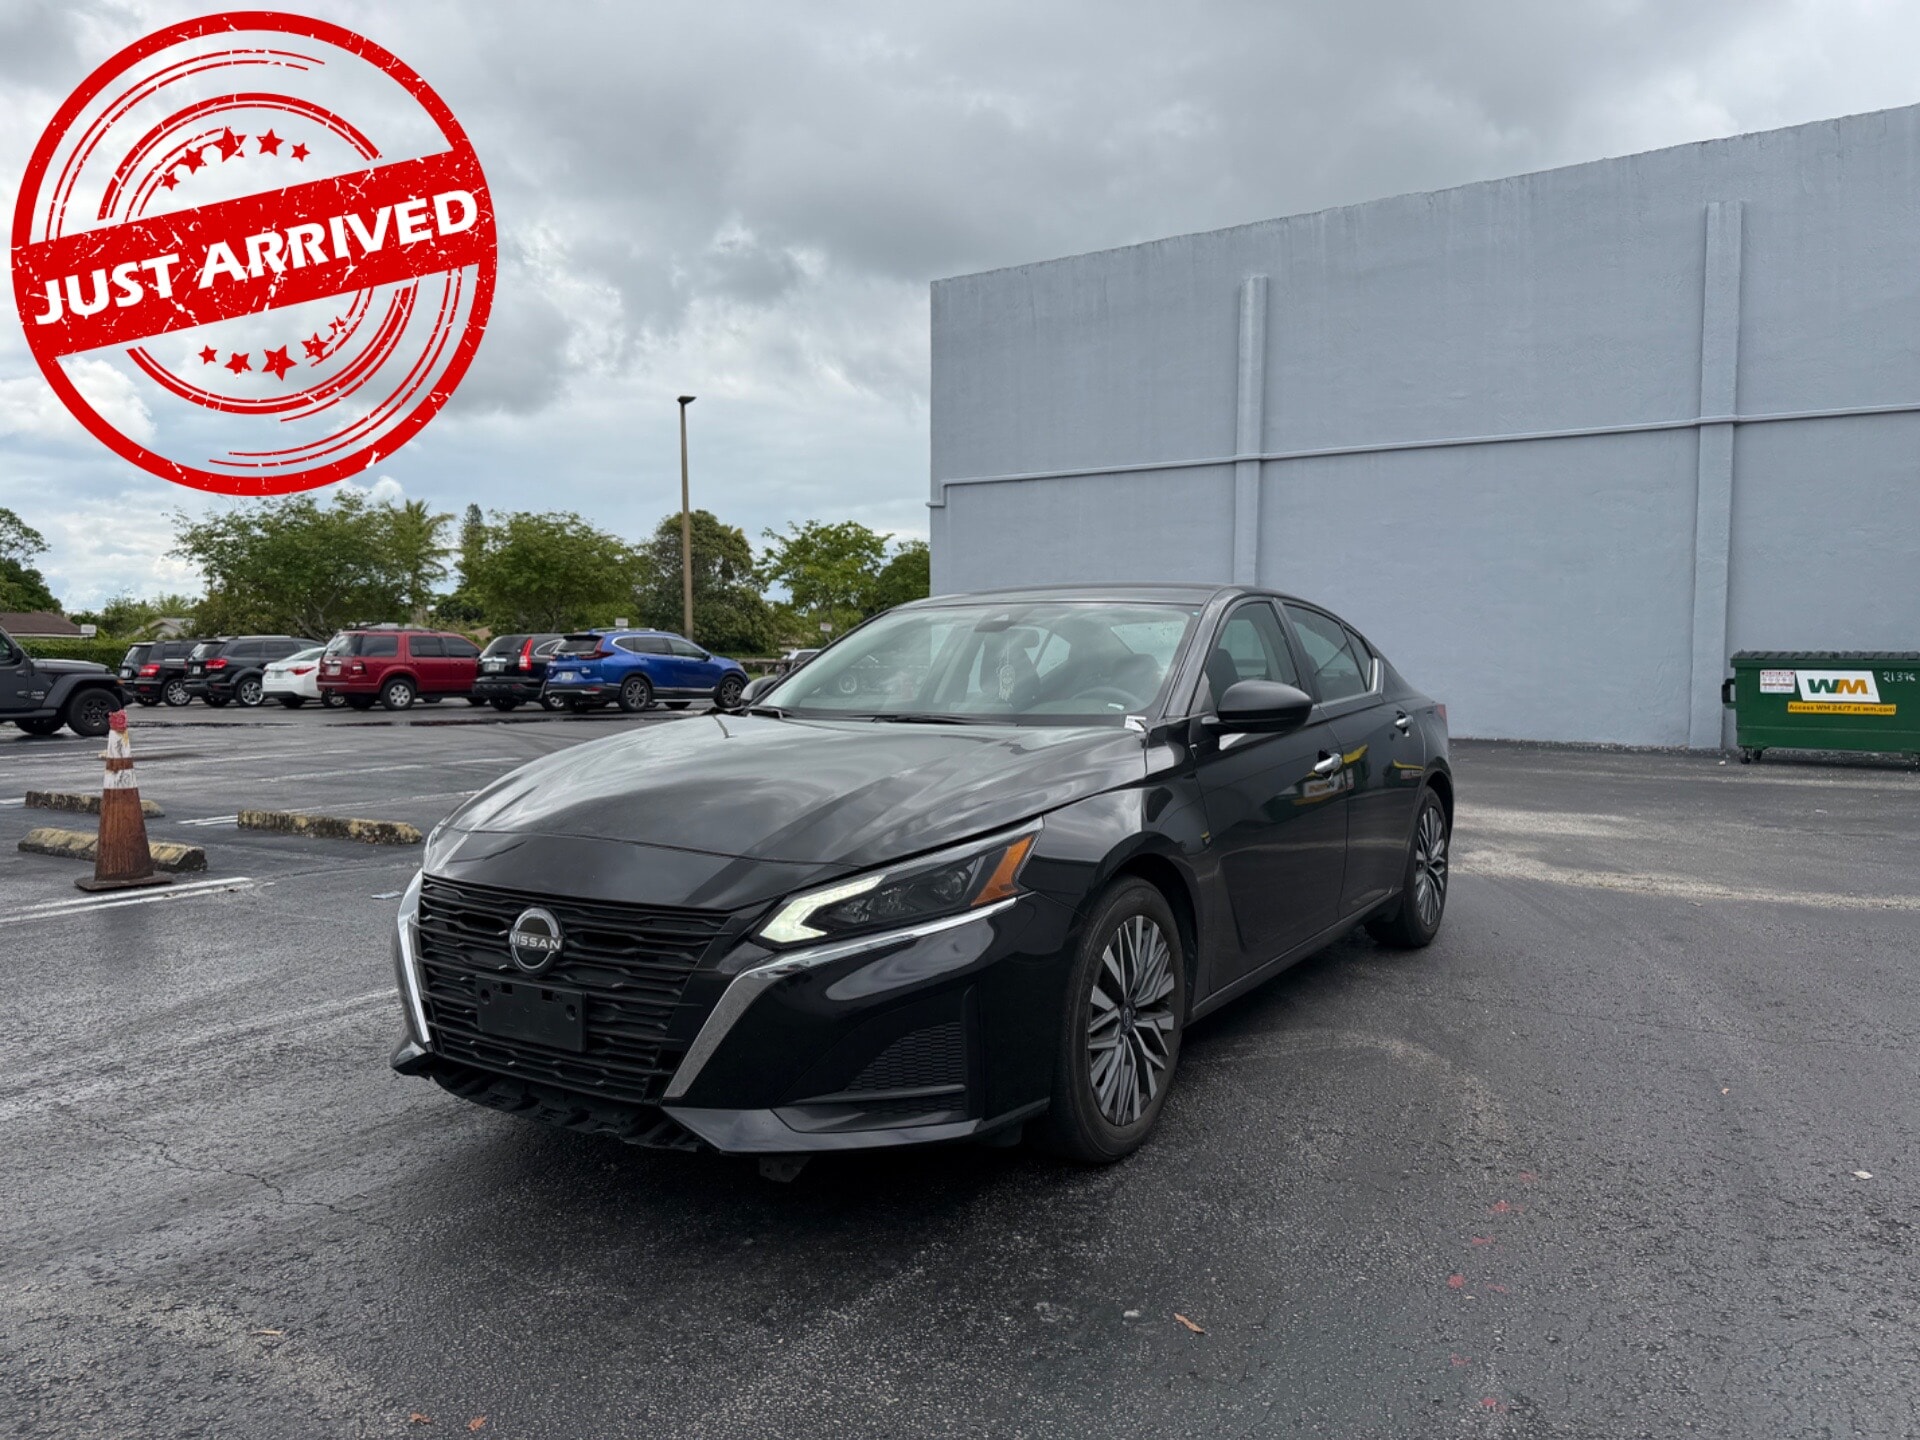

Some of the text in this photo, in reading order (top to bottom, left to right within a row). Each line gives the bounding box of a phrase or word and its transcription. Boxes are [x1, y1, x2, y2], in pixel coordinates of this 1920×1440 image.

[1807, 679, 1868, 694] WM
[1789, 703, 1814, 711] Access
[1816, 703, 1831, 712] WM
[1831, 704, 1852, 713] 24/7
[509, 932, 561, 950] NISSAN
